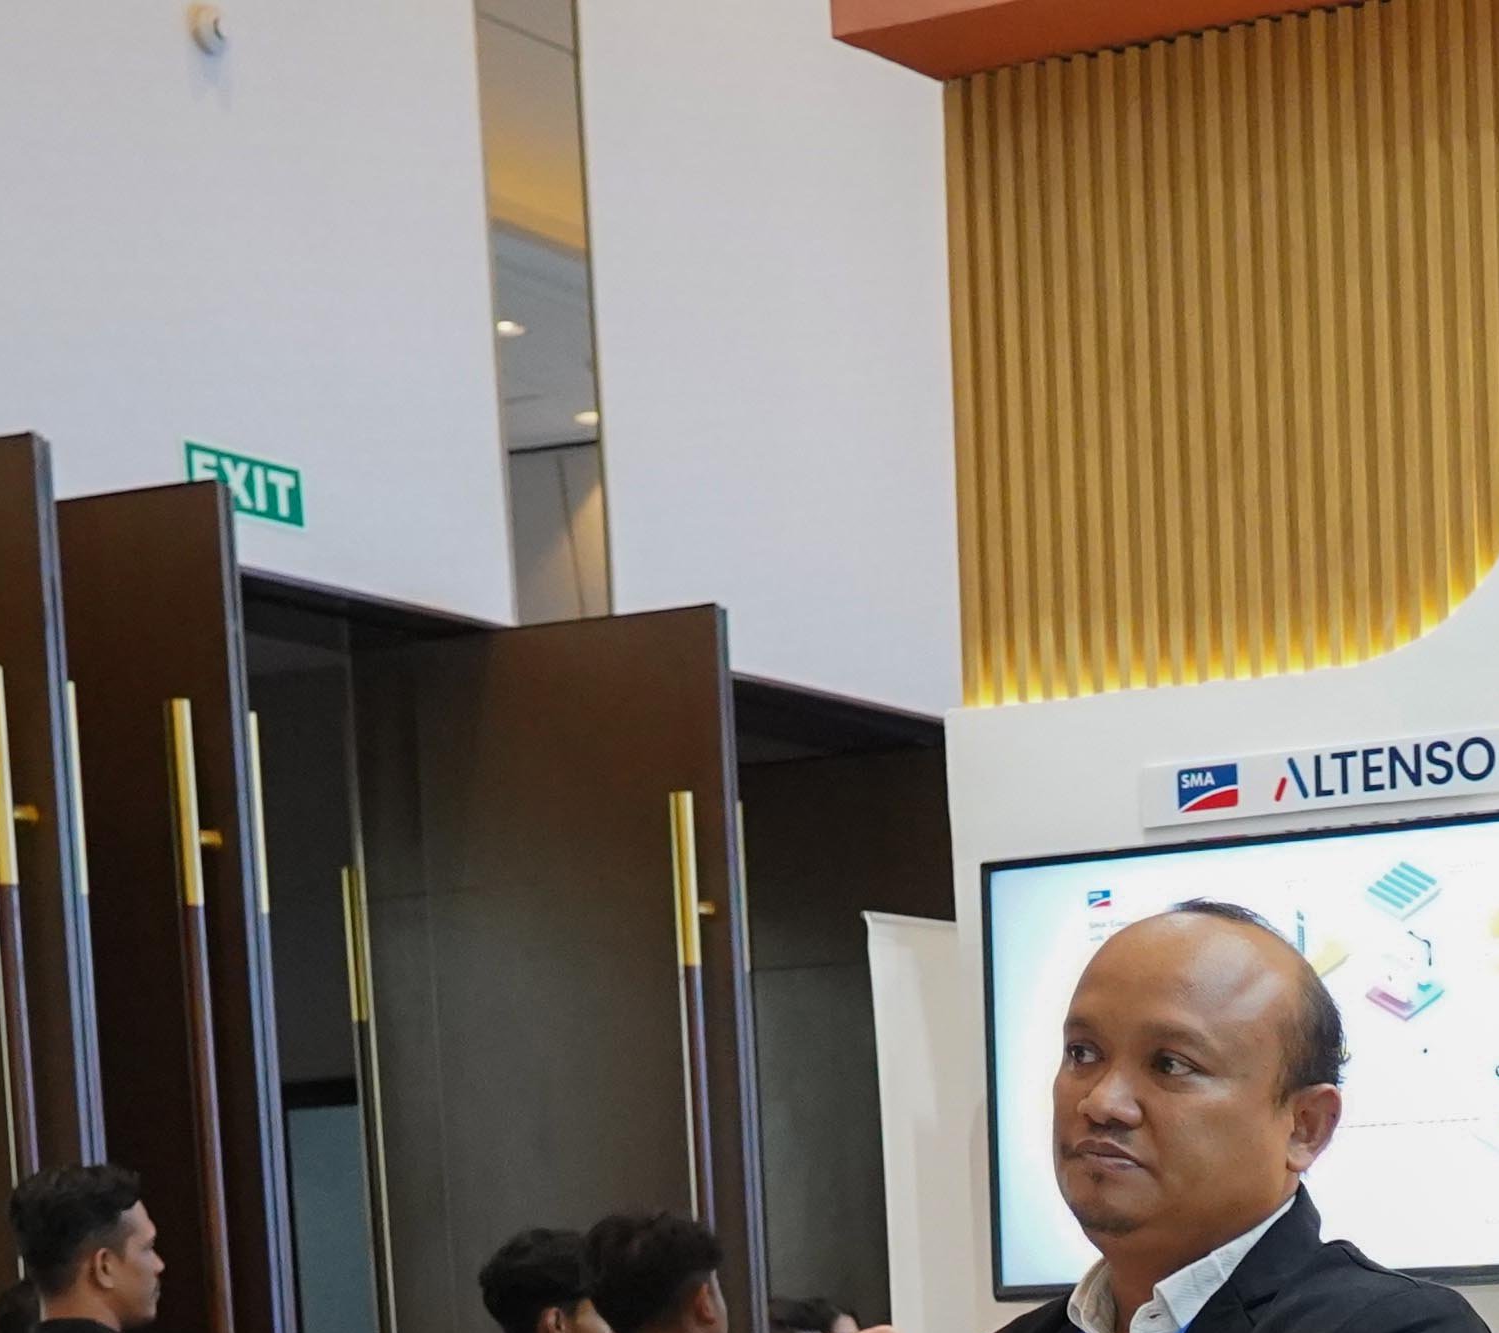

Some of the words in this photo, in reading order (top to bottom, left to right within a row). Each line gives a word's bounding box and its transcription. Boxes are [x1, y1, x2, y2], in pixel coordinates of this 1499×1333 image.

[191, 448, 296, 518] EXIT
[1181, 772, 1215, 790] SMA
[1274, 736, 1497, 802] ALTENSO
